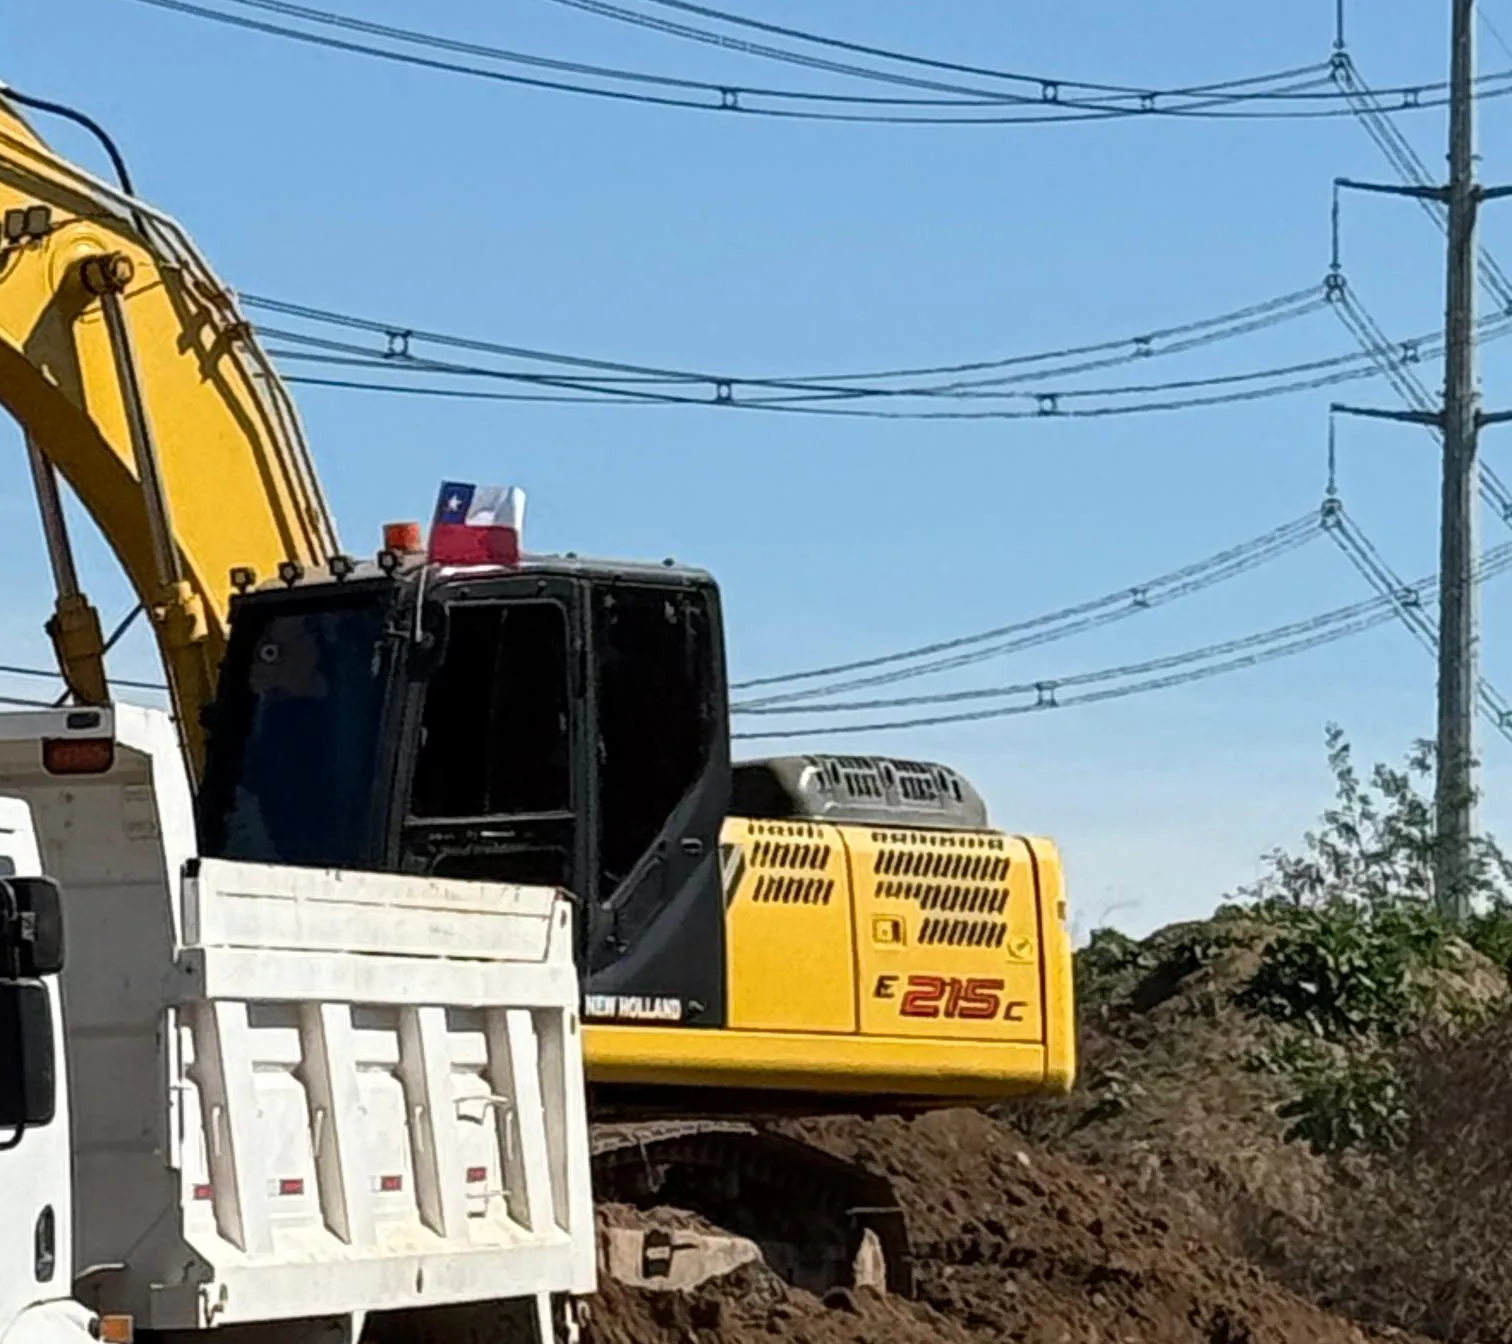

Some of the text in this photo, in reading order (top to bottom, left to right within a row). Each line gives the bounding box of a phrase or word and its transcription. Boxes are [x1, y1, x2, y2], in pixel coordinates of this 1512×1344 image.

[585, 994, 681, 1020] NEW HOLLAND
[873, 974, 1029, 1022] E 215 C
